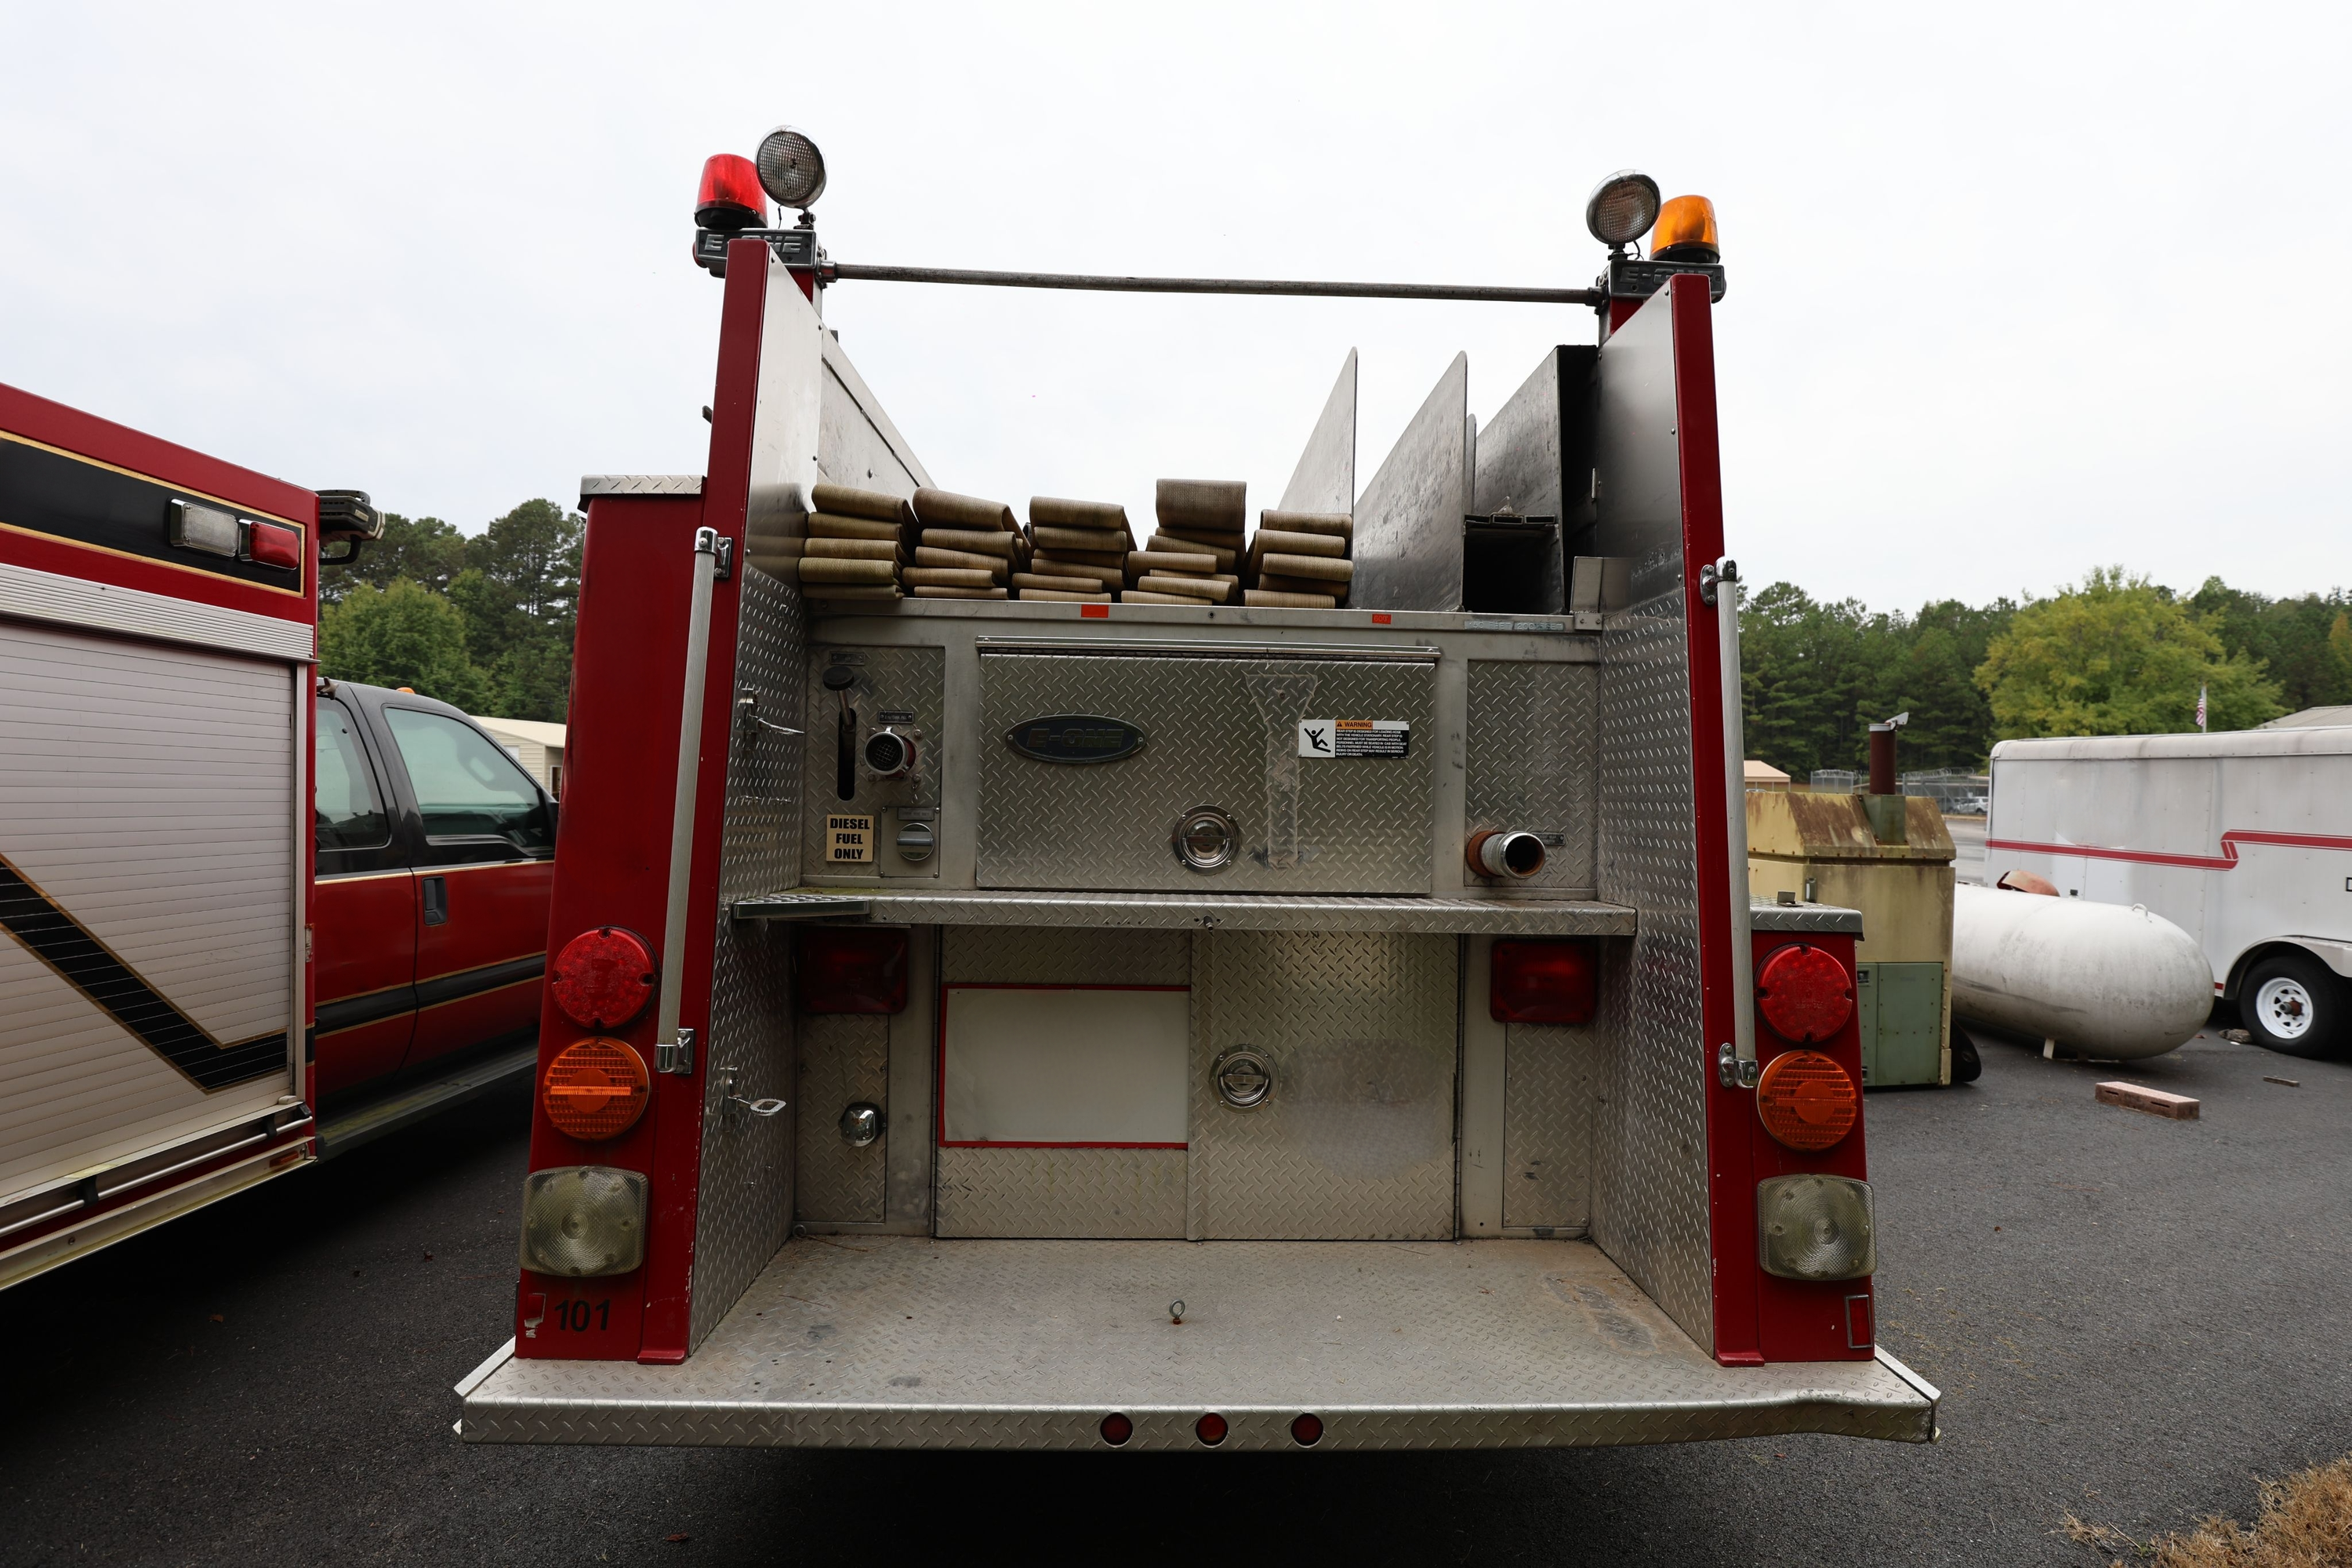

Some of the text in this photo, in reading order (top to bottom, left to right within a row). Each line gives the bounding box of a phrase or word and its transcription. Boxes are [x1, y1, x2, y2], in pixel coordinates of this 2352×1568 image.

[1025, 728, 1125, 749] E-ONE
[829, 818, 870, 829] DIESEL
[836, 833, 863, 844] FUEL
[834, 848, 864, 859] ONLY
[554, 1298, 611, 1332] 101
